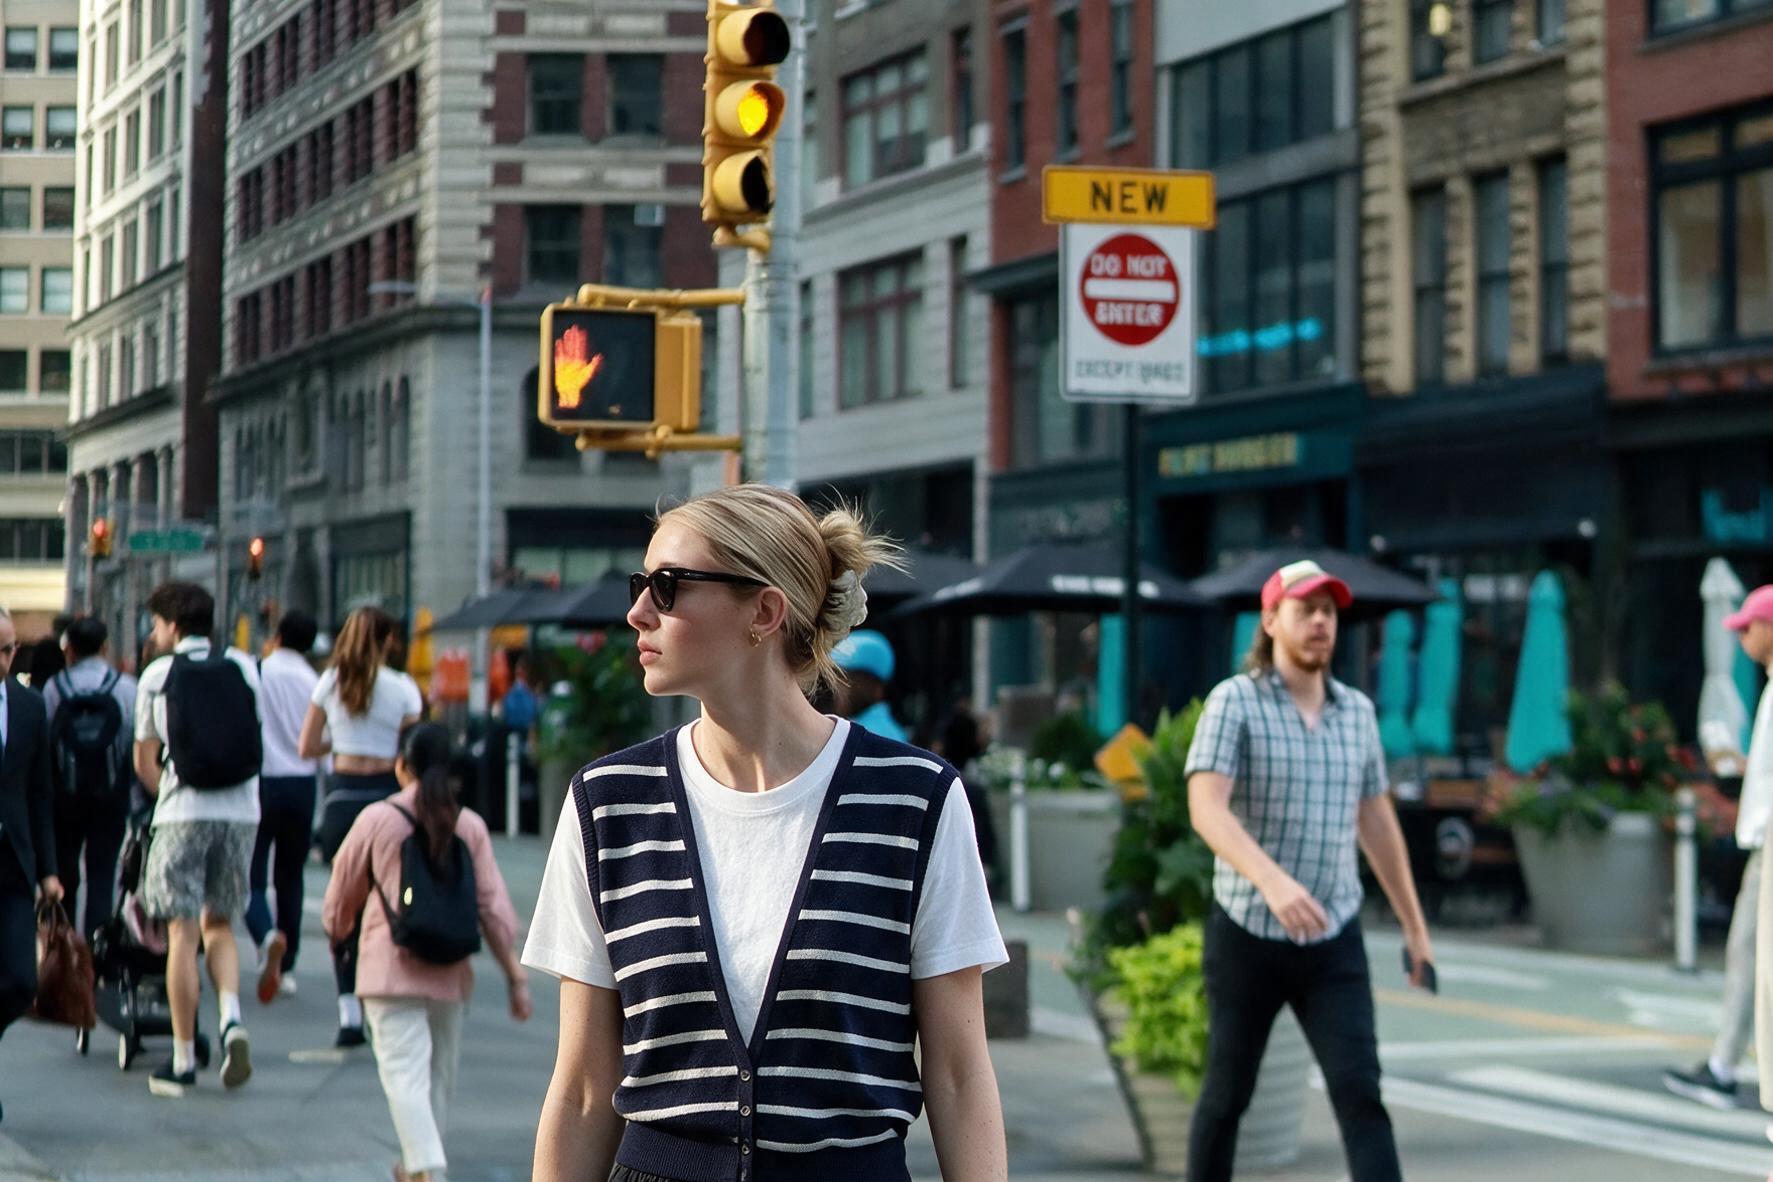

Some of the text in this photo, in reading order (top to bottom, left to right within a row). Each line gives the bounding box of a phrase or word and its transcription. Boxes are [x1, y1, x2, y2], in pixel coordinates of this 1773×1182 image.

[1090, 181, 1168, 213] NEW
[1090, 254, 1168, 277] DO NOT
[1095, 301, 1163, 327] ENTER
